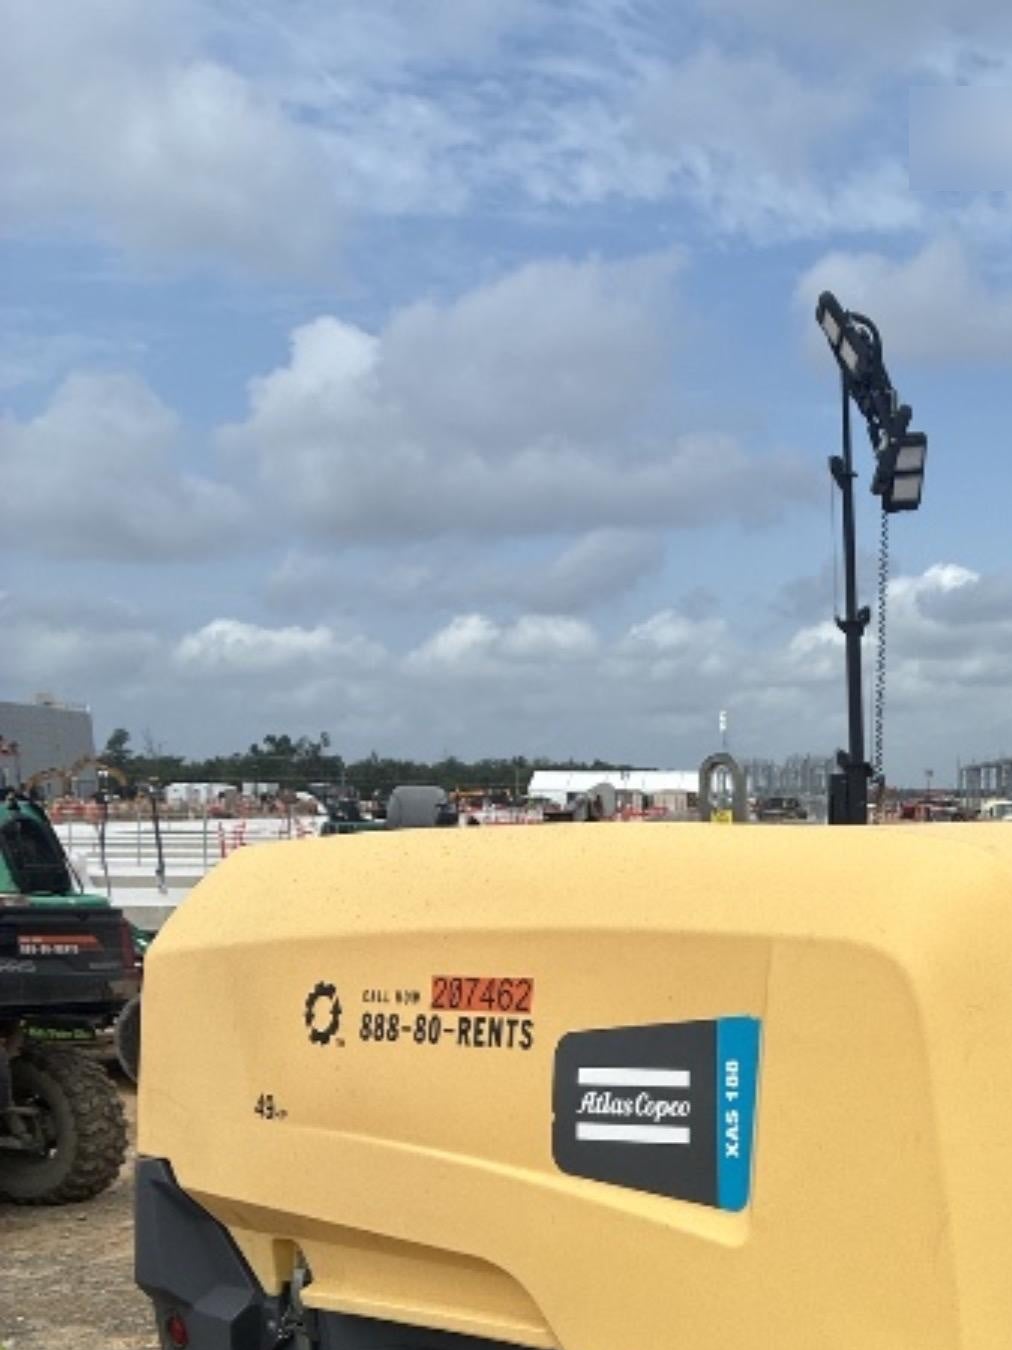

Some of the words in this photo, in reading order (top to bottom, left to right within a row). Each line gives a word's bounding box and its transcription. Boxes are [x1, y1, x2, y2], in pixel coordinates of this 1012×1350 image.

[431, 977, 532, 1012] 207462
[359, 1012, 535, 1050] 888-80-RENTS
[576, 1090, 633, 1115] Atlas
[634, 1091, 692, 1123] Copco
[725, 1109, 739, 1159] XAS
